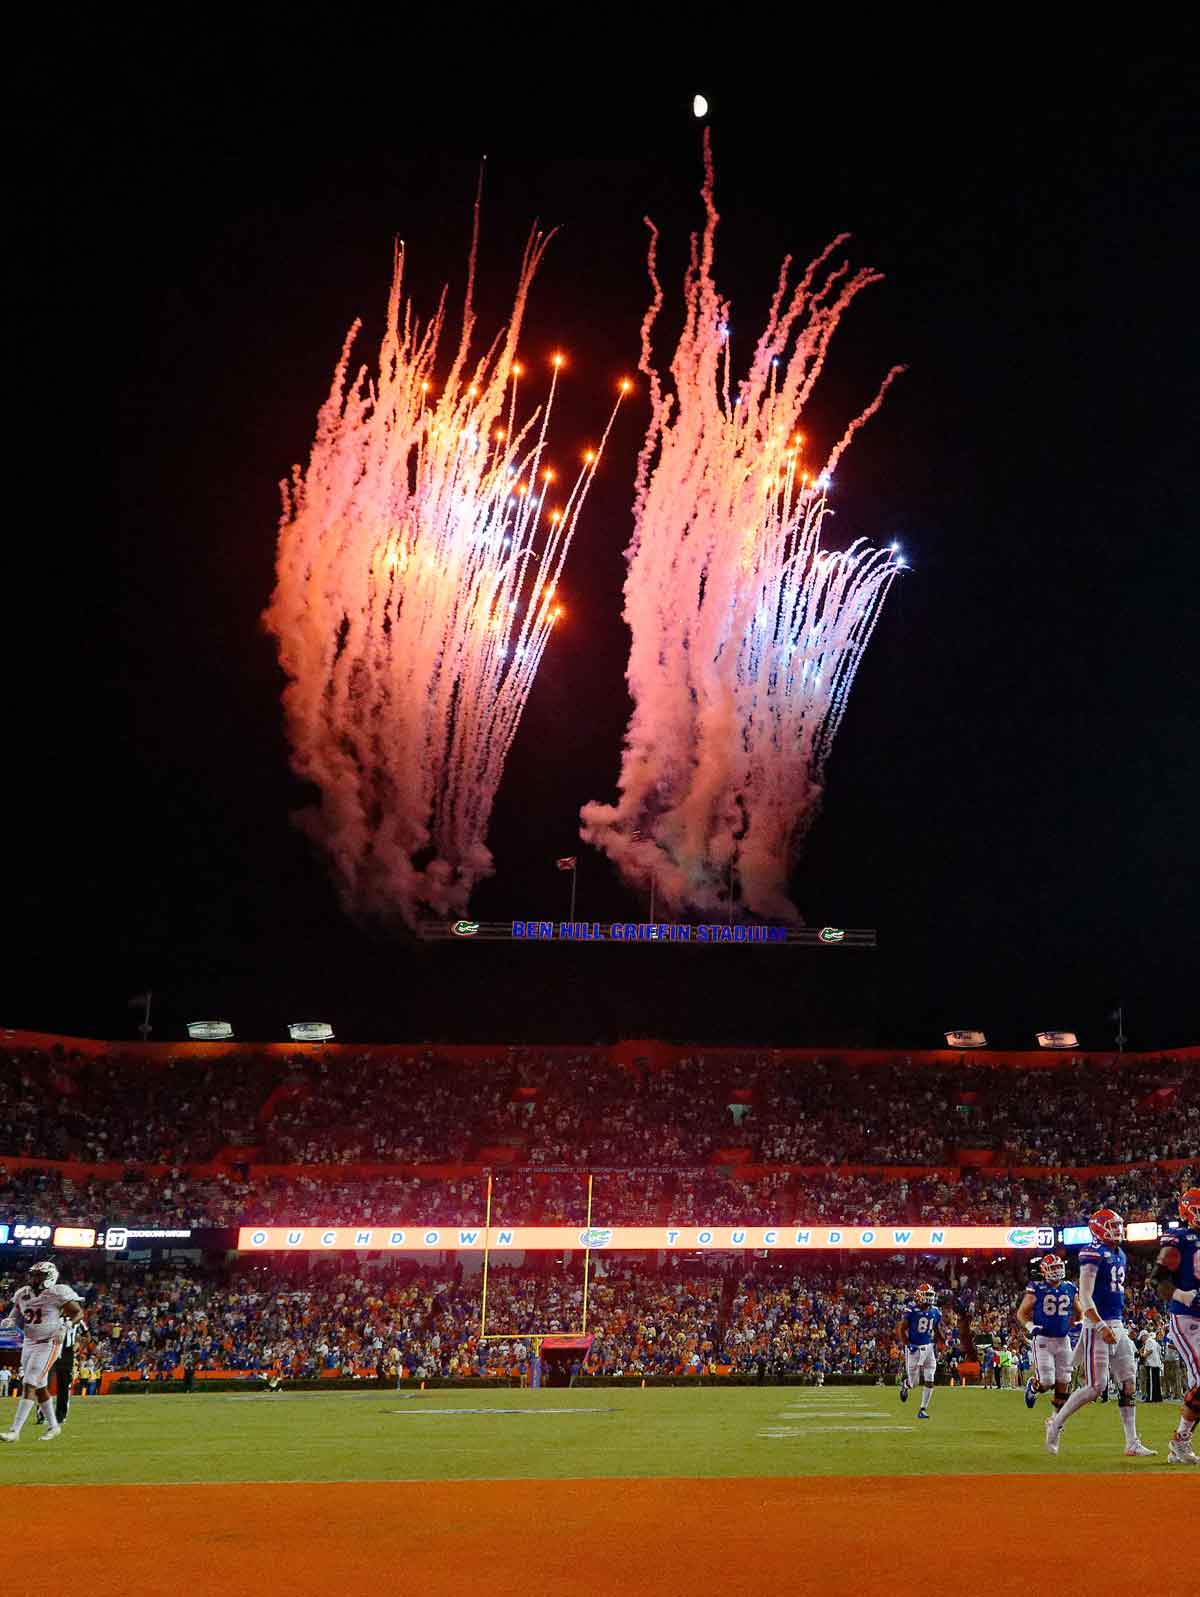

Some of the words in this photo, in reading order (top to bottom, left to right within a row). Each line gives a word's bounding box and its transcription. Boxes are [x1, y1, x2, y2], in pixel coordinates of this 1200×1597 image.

[512, 920, 554, 938] BEN
[559, 922, 604, 939] HILL
[609, 922, 691, 942] GRIFFIN
[667, 1230, 945, 1245] TOUCHDOWN
[1042, 1294, 1071, 1316] 62
